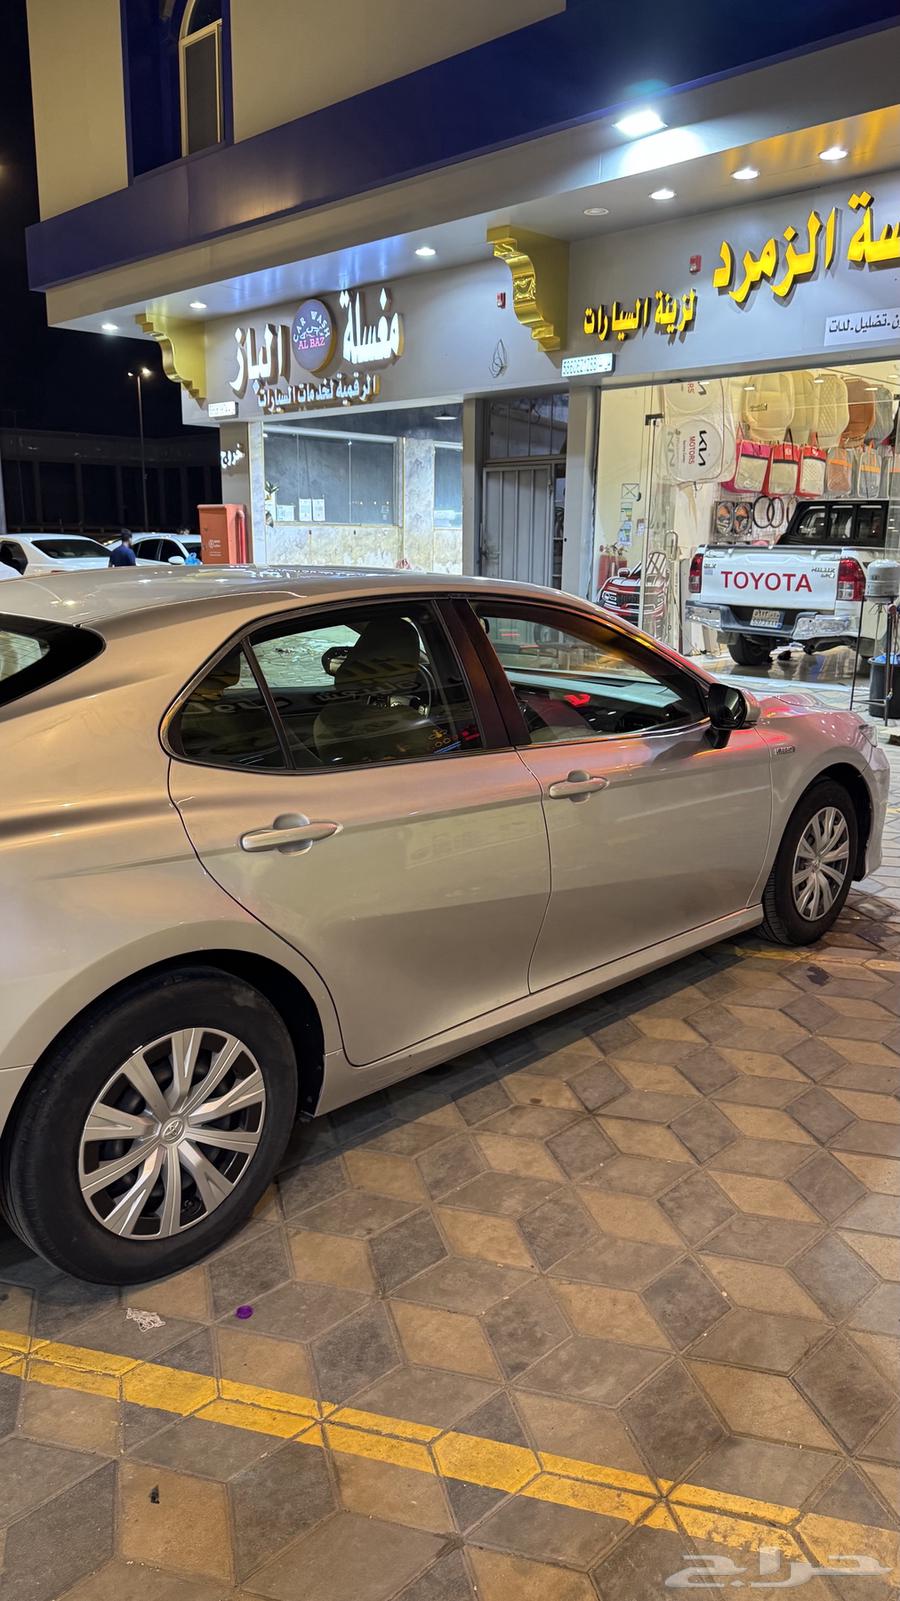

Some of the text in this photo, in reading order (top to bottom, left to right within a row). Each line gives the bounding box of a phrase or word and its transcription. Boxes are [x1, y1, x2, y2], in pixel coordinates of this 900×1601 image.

[712, 206, 837, 303] الزمرد
[293, 317, 306, 342] CAR
[310, 311, 330, 337] WASH
[583, 288, 695, 341] لزينة السيارات
[229, 288, 401, 394] مغسلة الباز
[298, 336, 325, 350] AL BAZ
[258, 383, 296, 413] السيارات
[298, 378, 334, 403] لخدمات
[688, 435, 696, 465] MOTORS
[698, 430, 708, 466] KIA
[721, 571, 813, 593] TOYOTA
